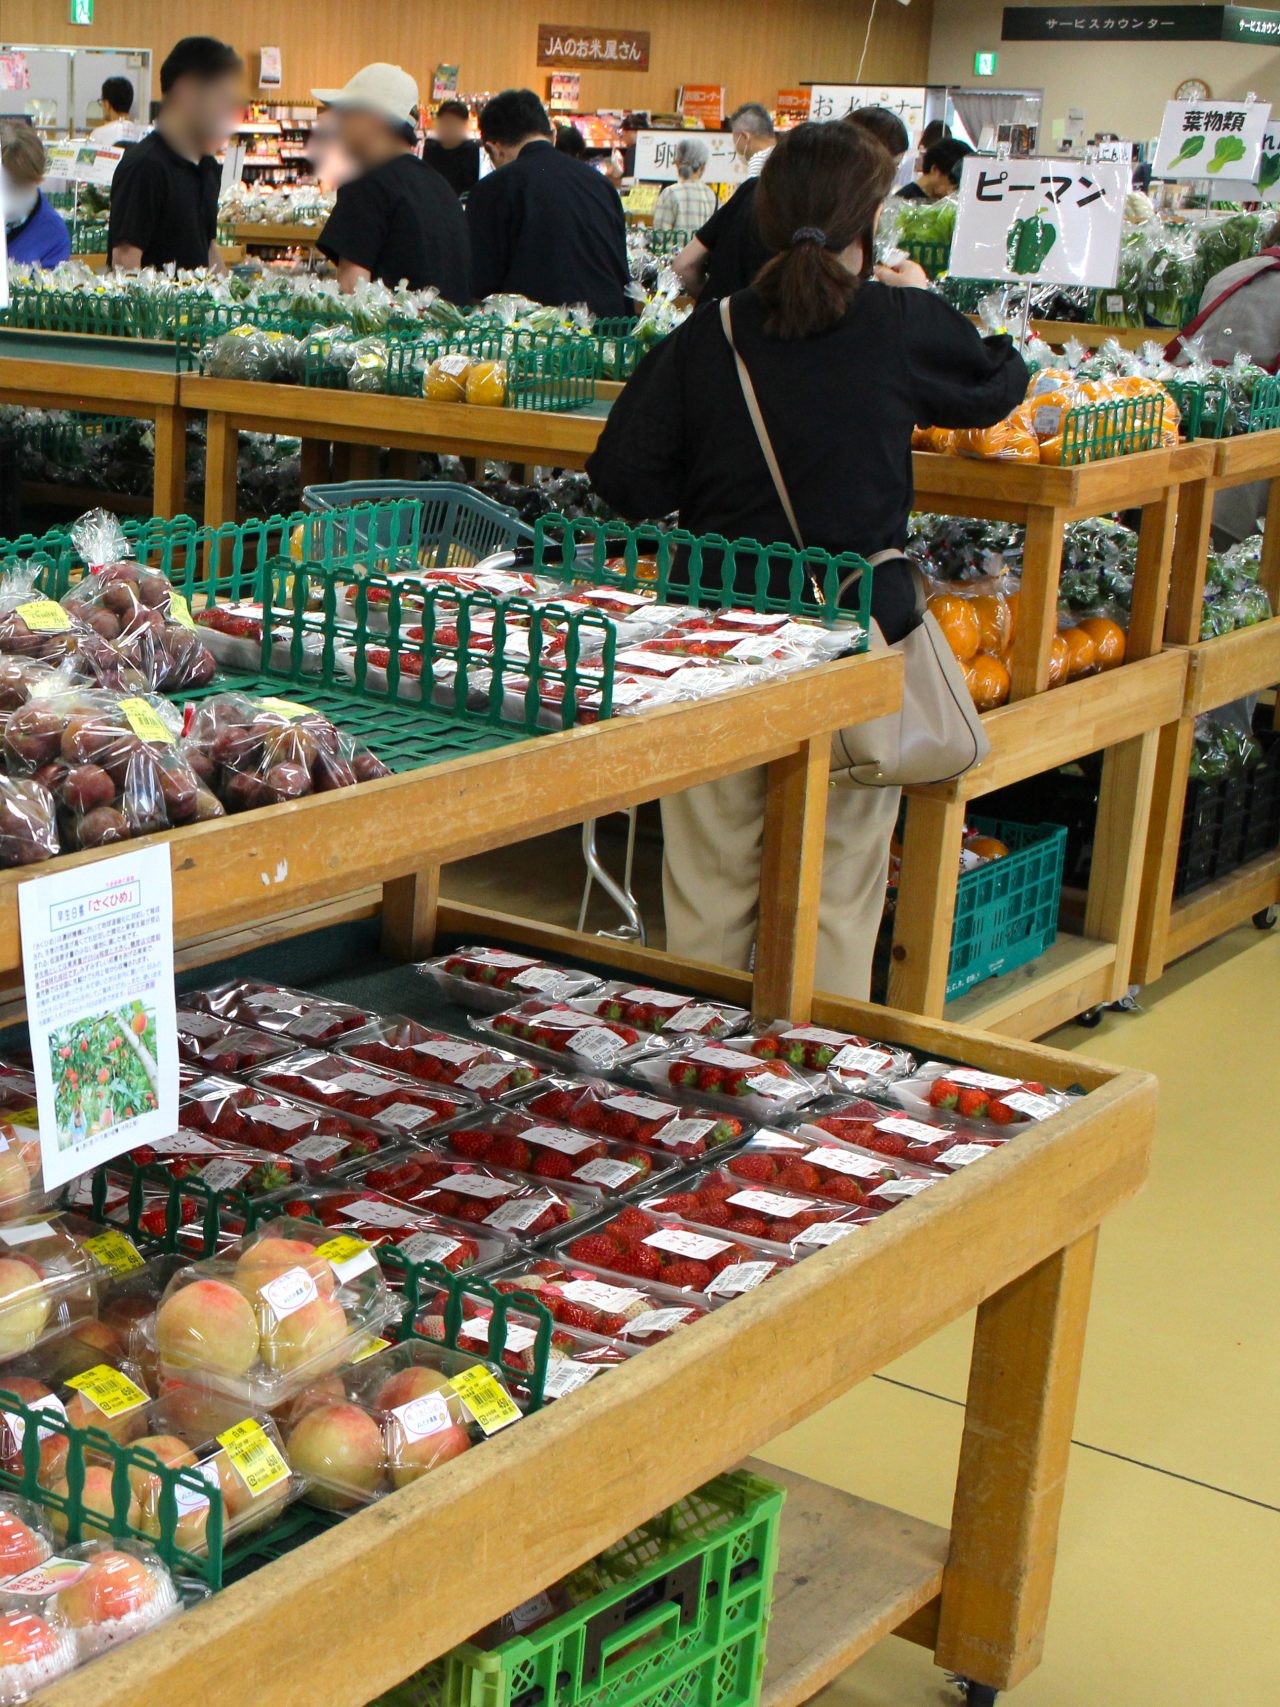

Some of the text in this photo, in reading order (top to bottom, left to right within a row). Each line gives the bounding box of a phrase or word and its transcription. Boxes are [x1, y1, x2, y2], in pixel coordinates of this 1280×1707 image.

[1046, 18, 1175, 30] サービスカウンター
[545, 37, 641, 60] JAのお米屋さん
[1183, 110, 1247, 132] 葉物類
[976, 171, 1106, 207] ピーマン
[27, 1579, 58, 1593] もも
